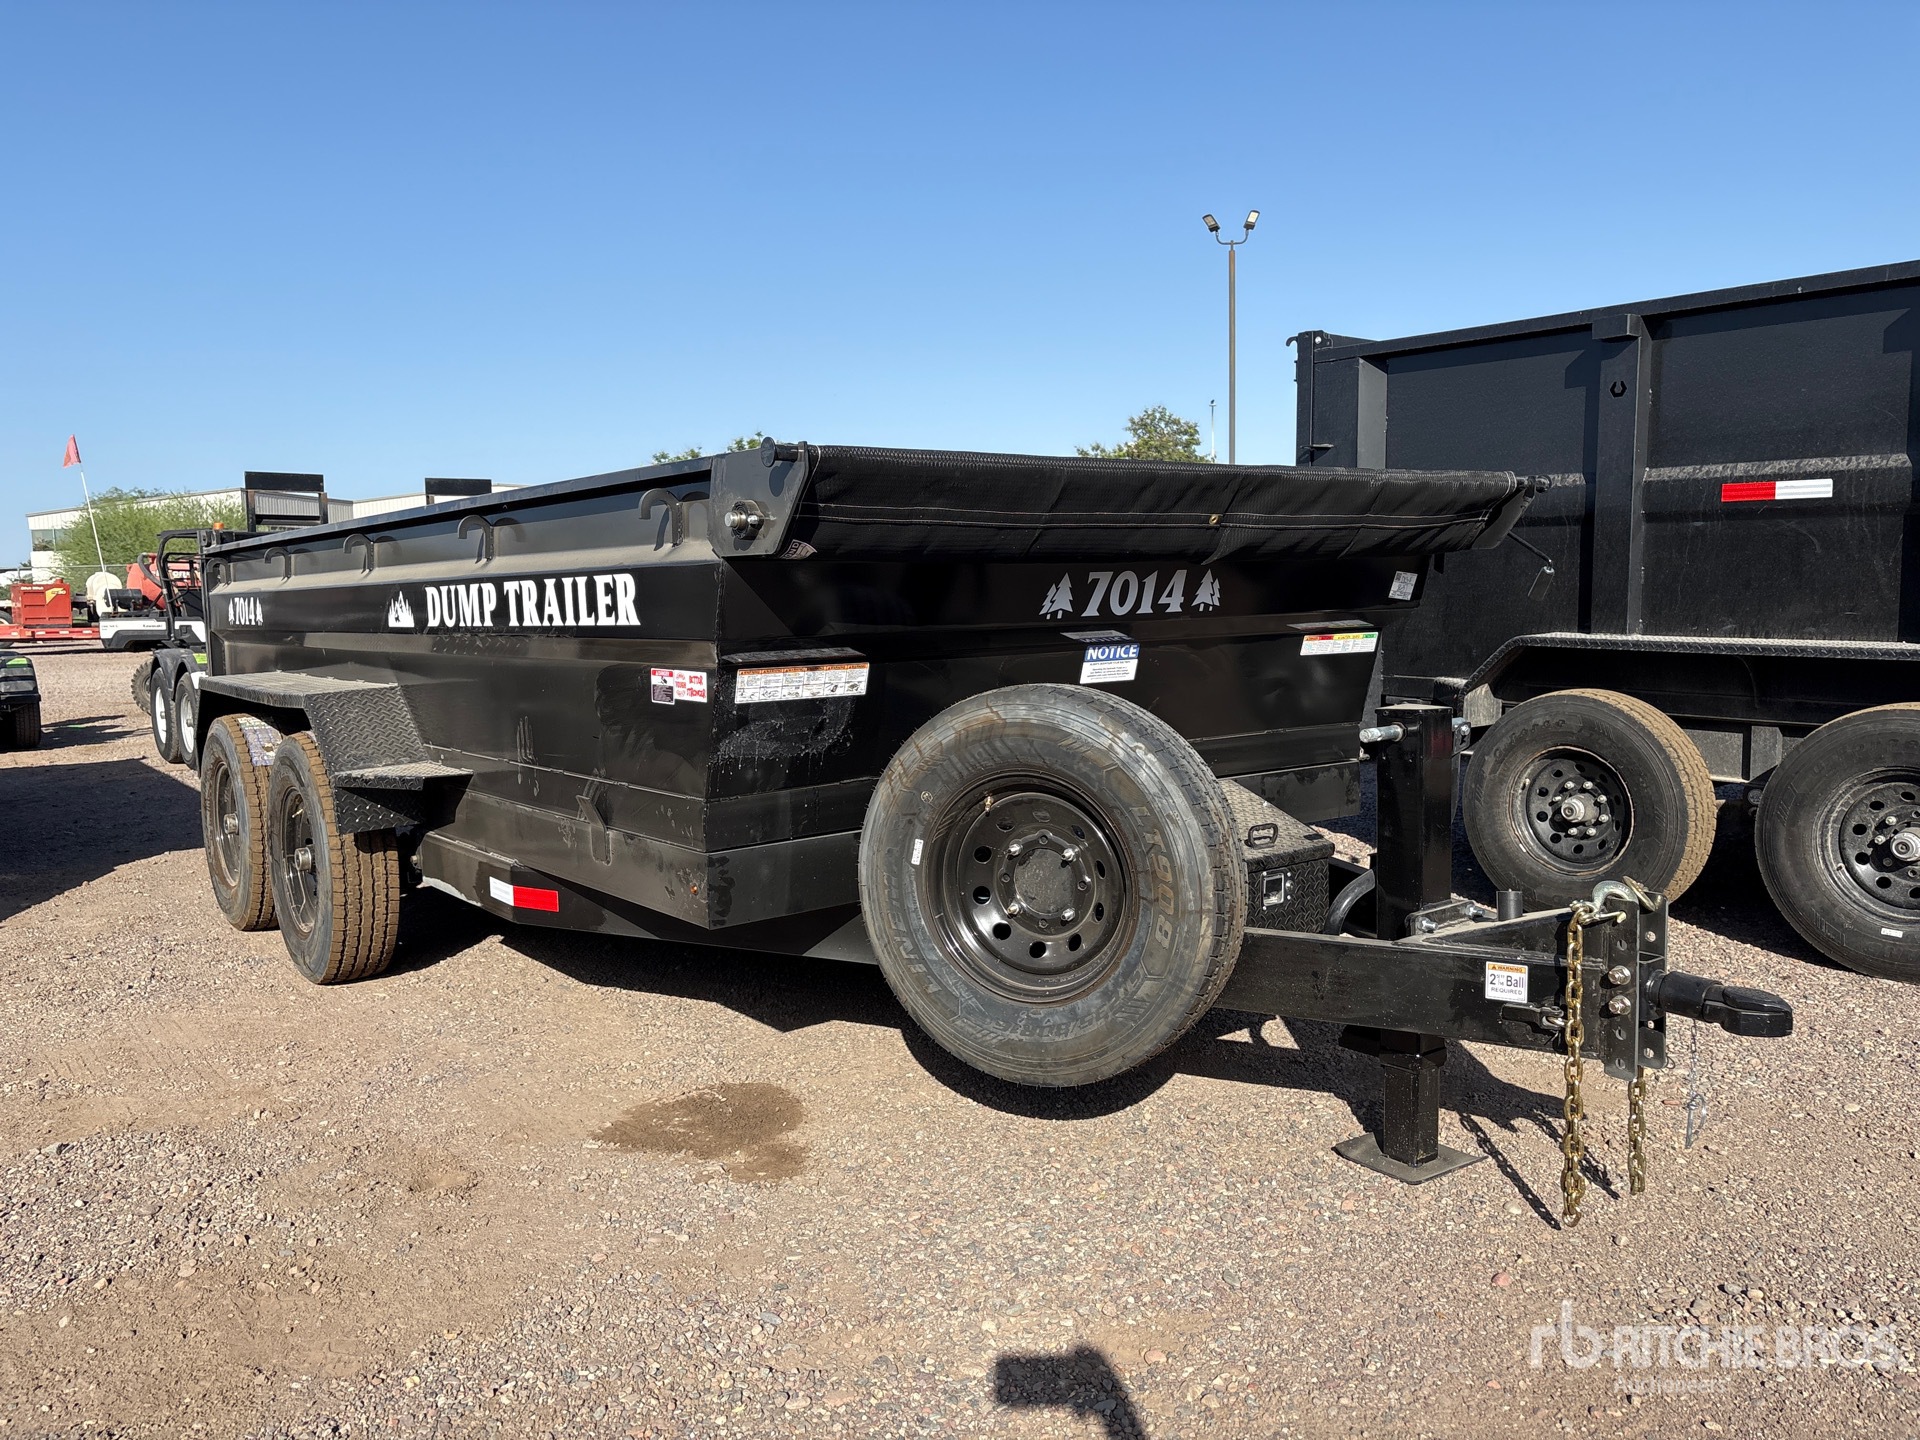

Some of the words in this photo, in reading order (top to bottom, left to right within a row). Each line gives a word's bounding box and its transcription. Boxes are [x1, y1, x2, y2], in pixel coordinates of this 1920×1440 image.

[424, 582, 497, 628] DUMP
[504, 573, 641, 627] TRAILER
[1081, 570, 1187, 617] 7014
[234, 597, 256, 626] 7014
[1087, 645, 1138, 660] NOTICE
[1490, 973, 1497, 985] 2
[1506, 975, 1524, 988] Ball
[1491, 986, 1522, 995] REQUIRED
